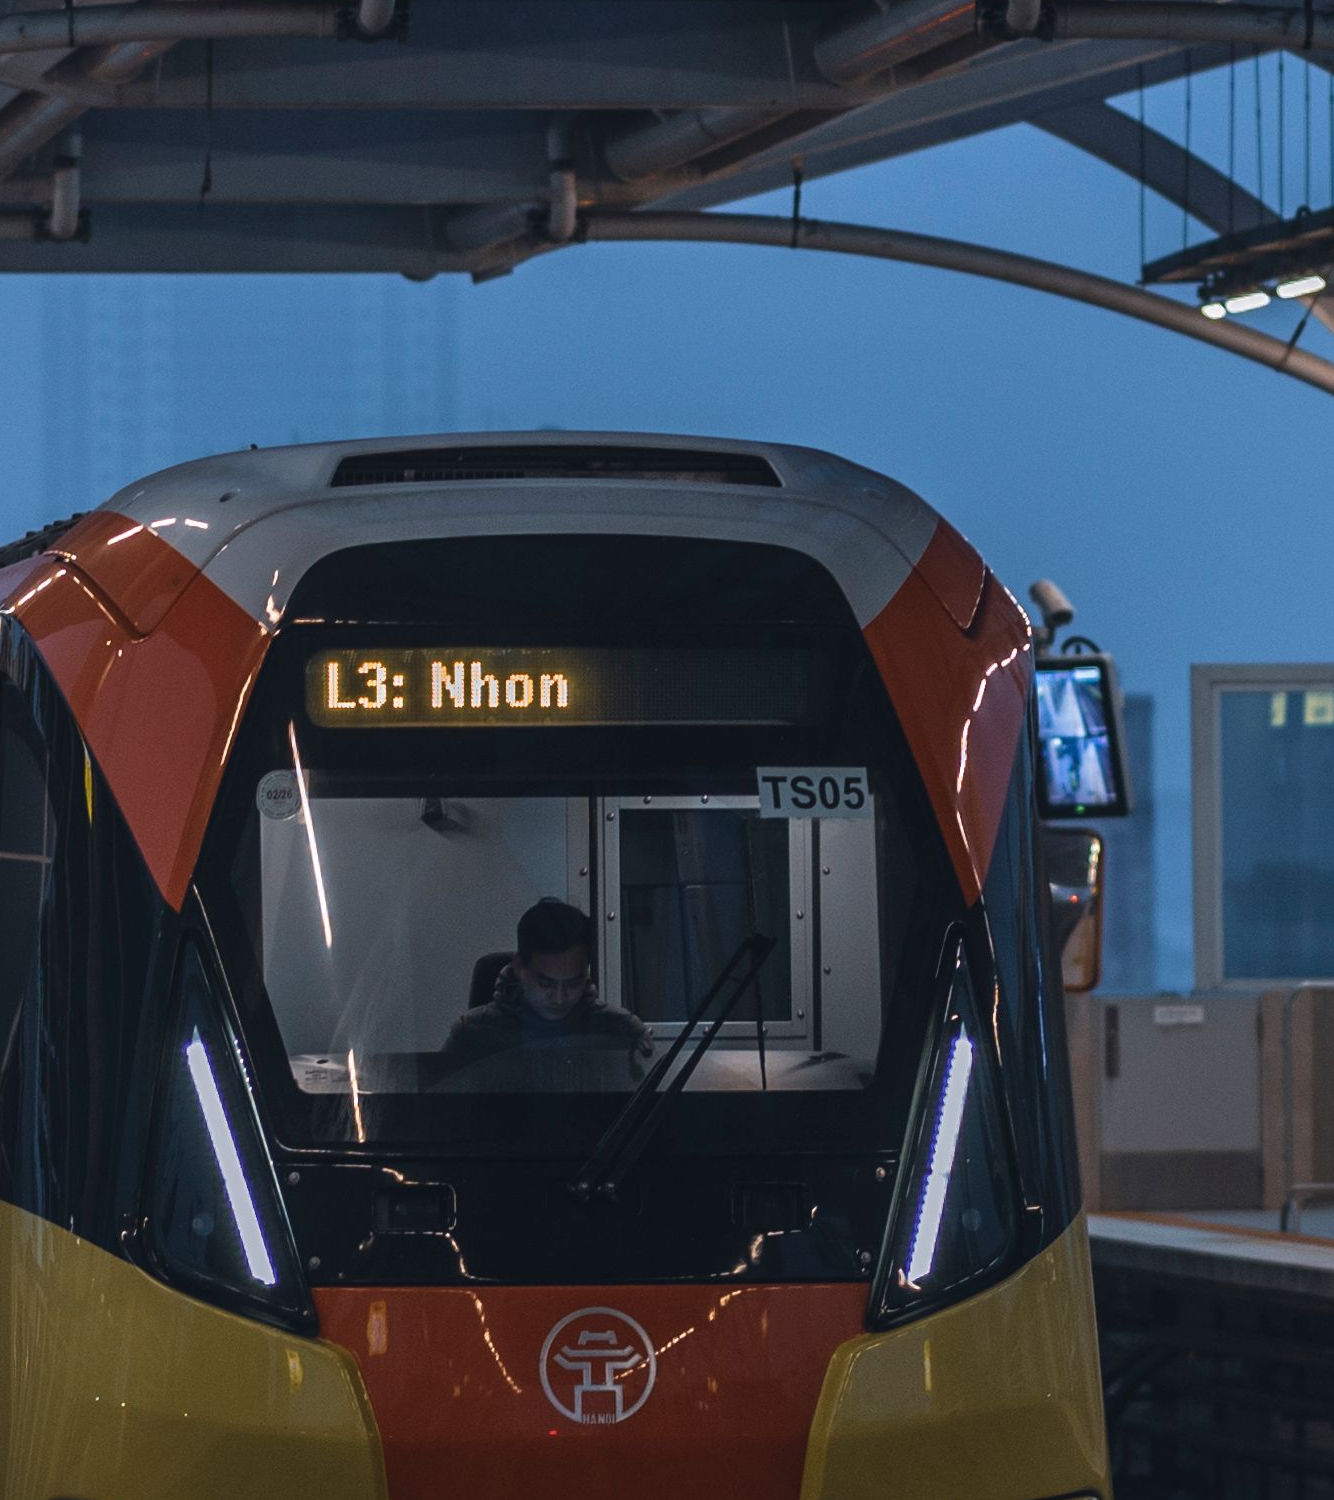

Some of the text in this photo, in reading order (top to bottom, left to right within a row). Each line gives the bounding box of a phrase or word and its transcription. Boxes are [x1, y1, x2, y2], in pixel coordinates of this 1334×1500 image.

[325, 661, 569, 709] L3: Nhon
[762, 776, 865, 809] TS05
